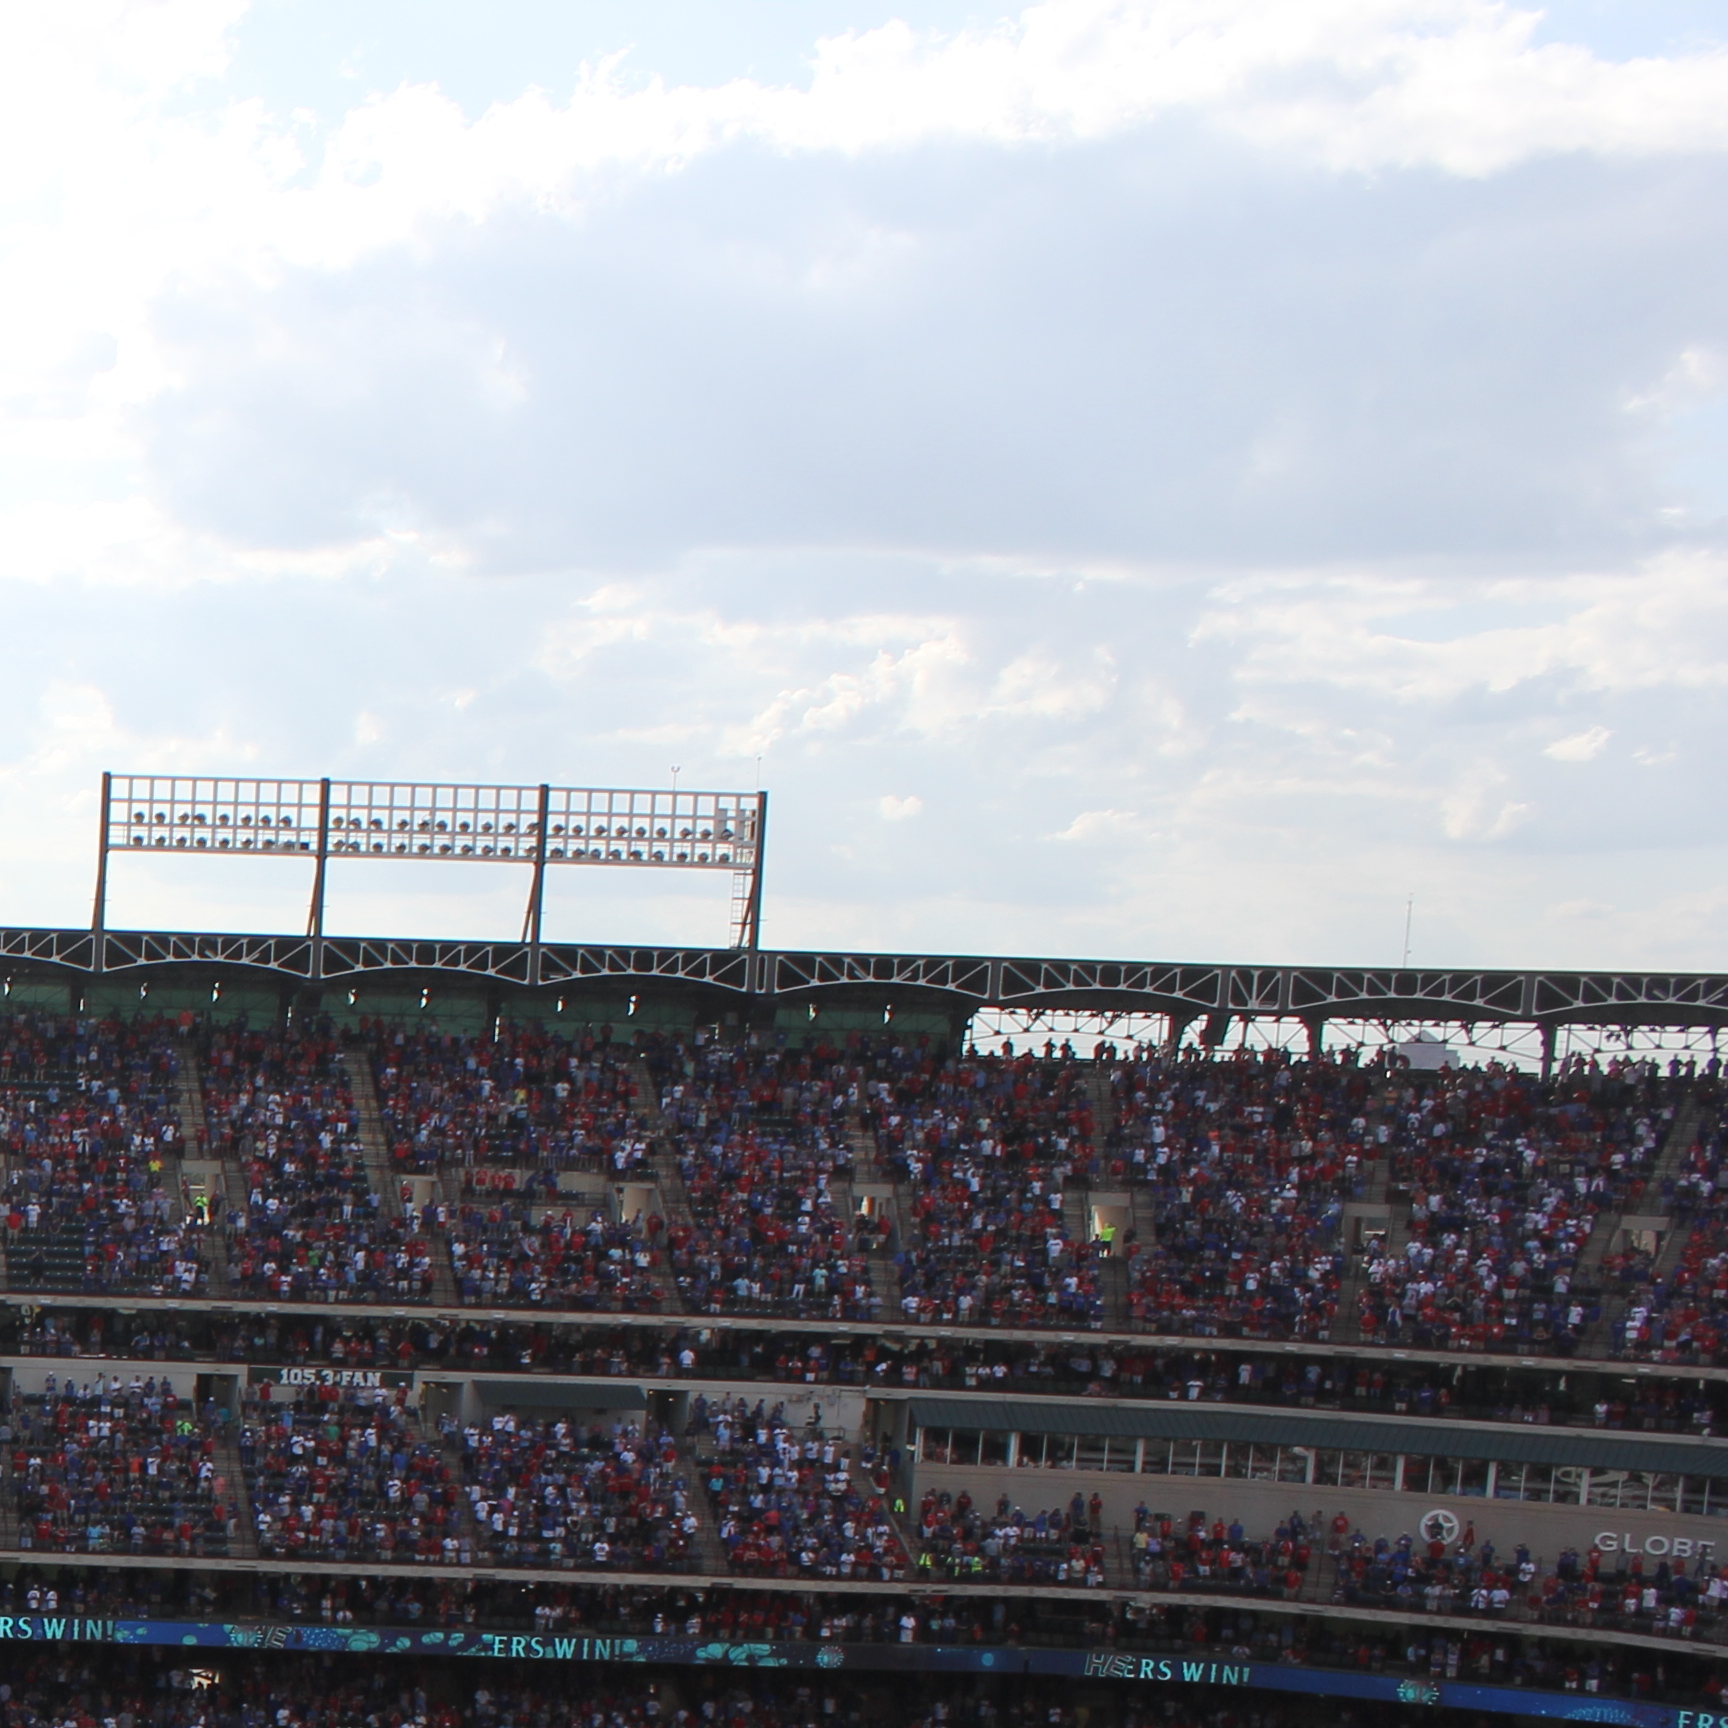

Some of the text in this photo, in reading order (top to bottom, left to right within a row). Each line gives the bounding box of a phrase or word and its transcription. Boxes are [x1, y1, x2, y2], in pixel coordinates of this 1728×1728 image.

[280, 1368, 382, 1387] 105.3 FAN
[1594, 1532, 1716, 1560] GLOBE
[43, 1617, 114, 1642] WIN!
[493, 1635, 621, 1661] ERS WIN!
[1182, 1660, 1251, 1687] WIN!
